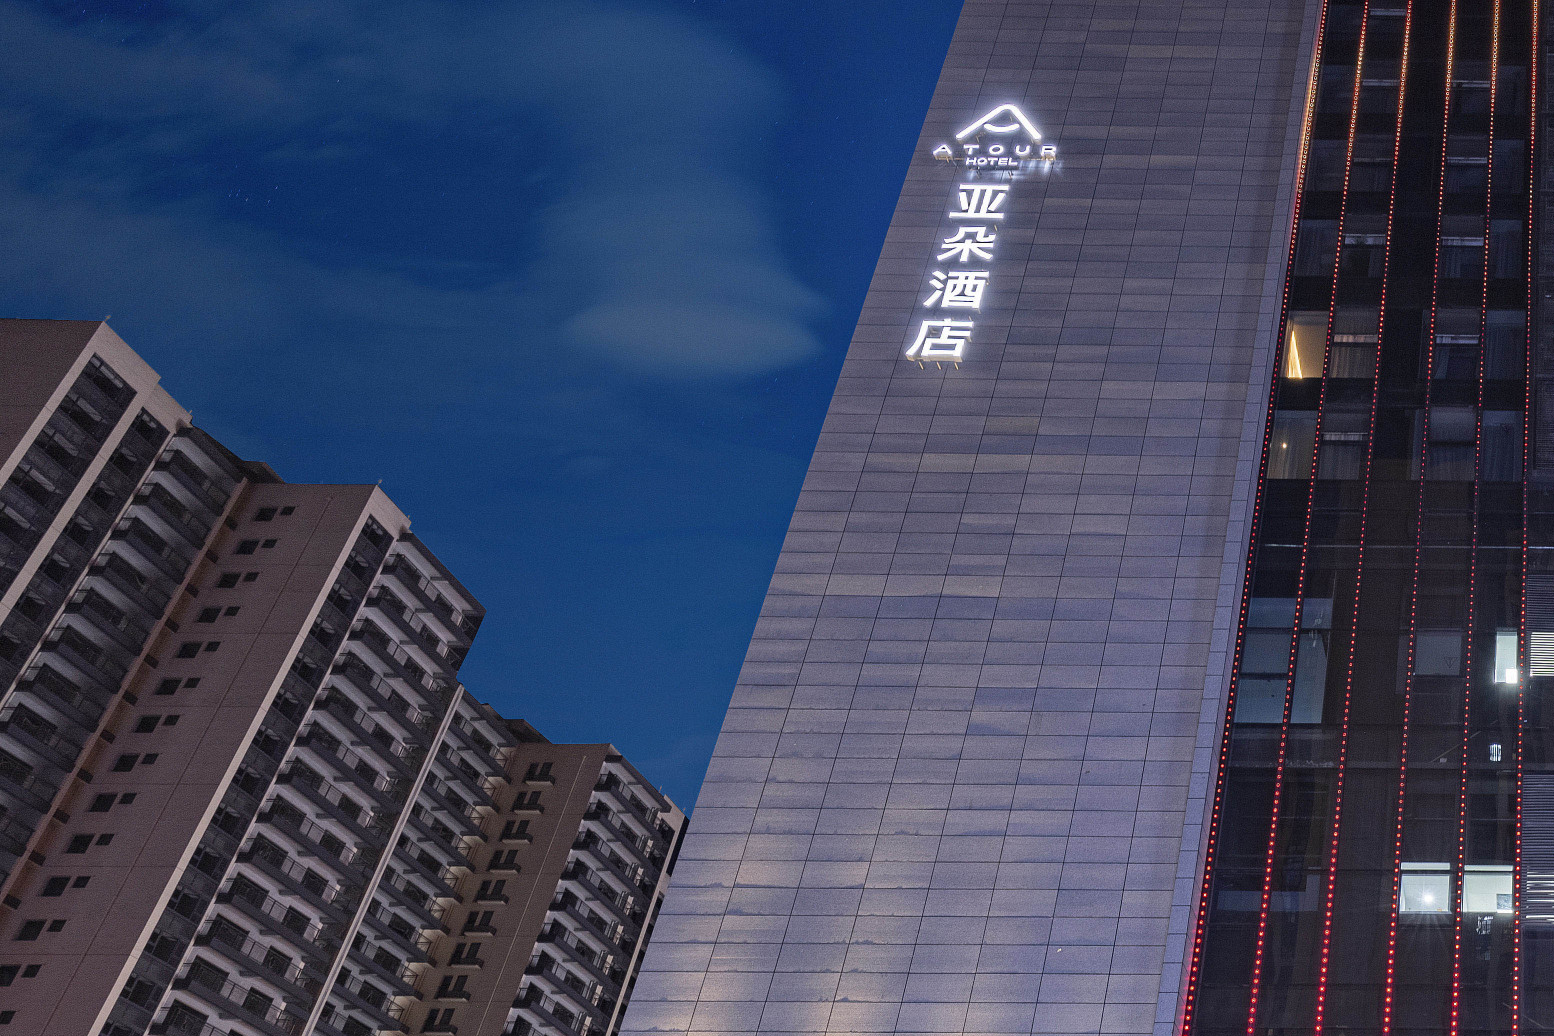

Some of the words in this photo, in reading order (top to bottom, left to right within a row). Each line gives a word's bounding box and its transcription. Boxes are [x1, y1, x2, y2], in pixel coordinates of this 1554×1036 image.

[933, 144, 1057, 157] ATOUR
[965, 157, 1018, 166] HOTEL
[905, 184, 1010, 363] 亚朵酒店
